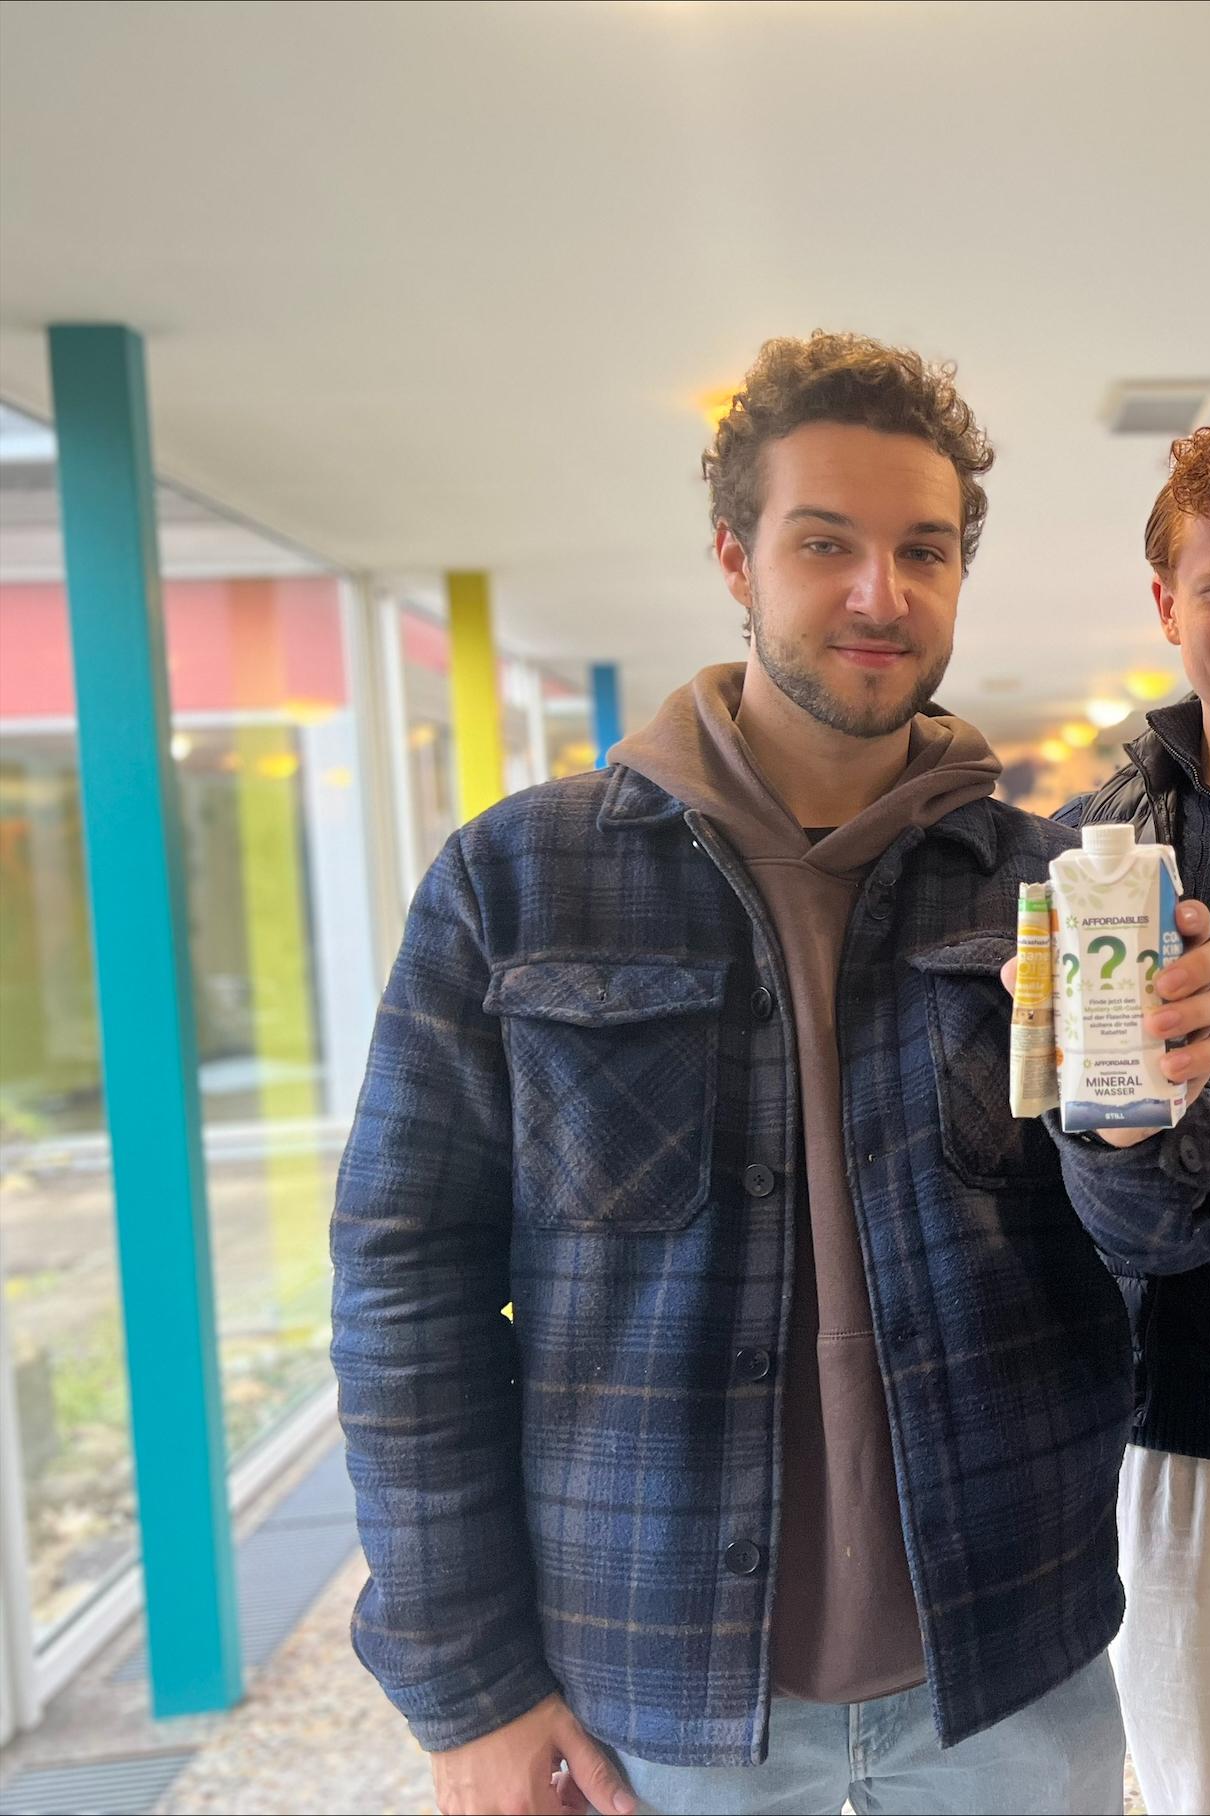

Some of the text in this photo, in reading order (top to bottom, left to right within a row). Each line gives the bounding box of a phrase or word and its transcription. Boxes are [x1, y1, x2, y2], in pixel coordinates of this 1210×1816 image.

[1082, 916, 1149, 926] AFFORDABLES
[1087, 935, 1126, 990] ?
[1086, 1076, 1142, 1087] MINERAL
[1095, 1087, 1135, 1096] WASSER
